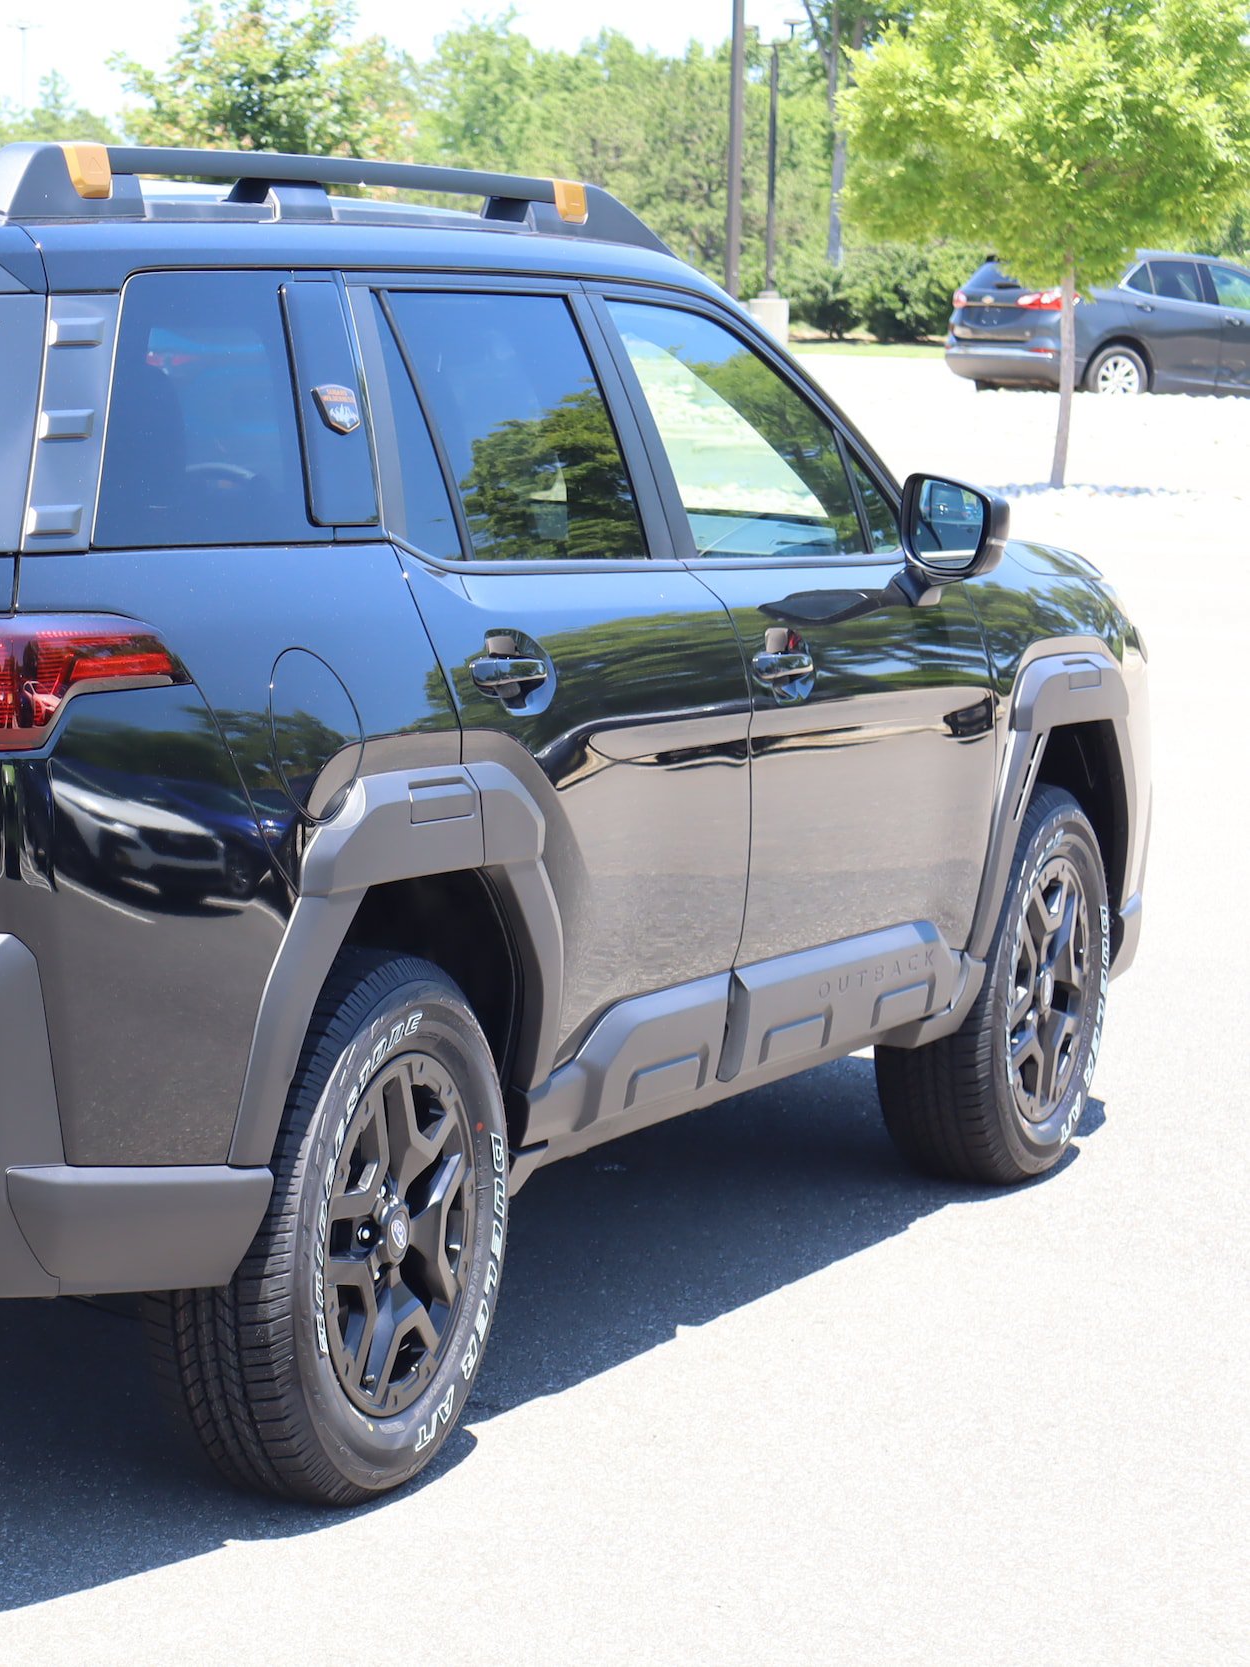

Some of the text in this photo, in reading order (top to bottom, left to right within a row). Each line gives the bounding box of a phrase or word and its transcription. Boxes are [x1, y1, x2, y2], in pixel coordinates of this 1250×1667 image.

[818, 949, 935, 998] OUTBACK
[460, 1132, 505, 1380] DUELER
[414, 1383, 455, 1453] A/T
